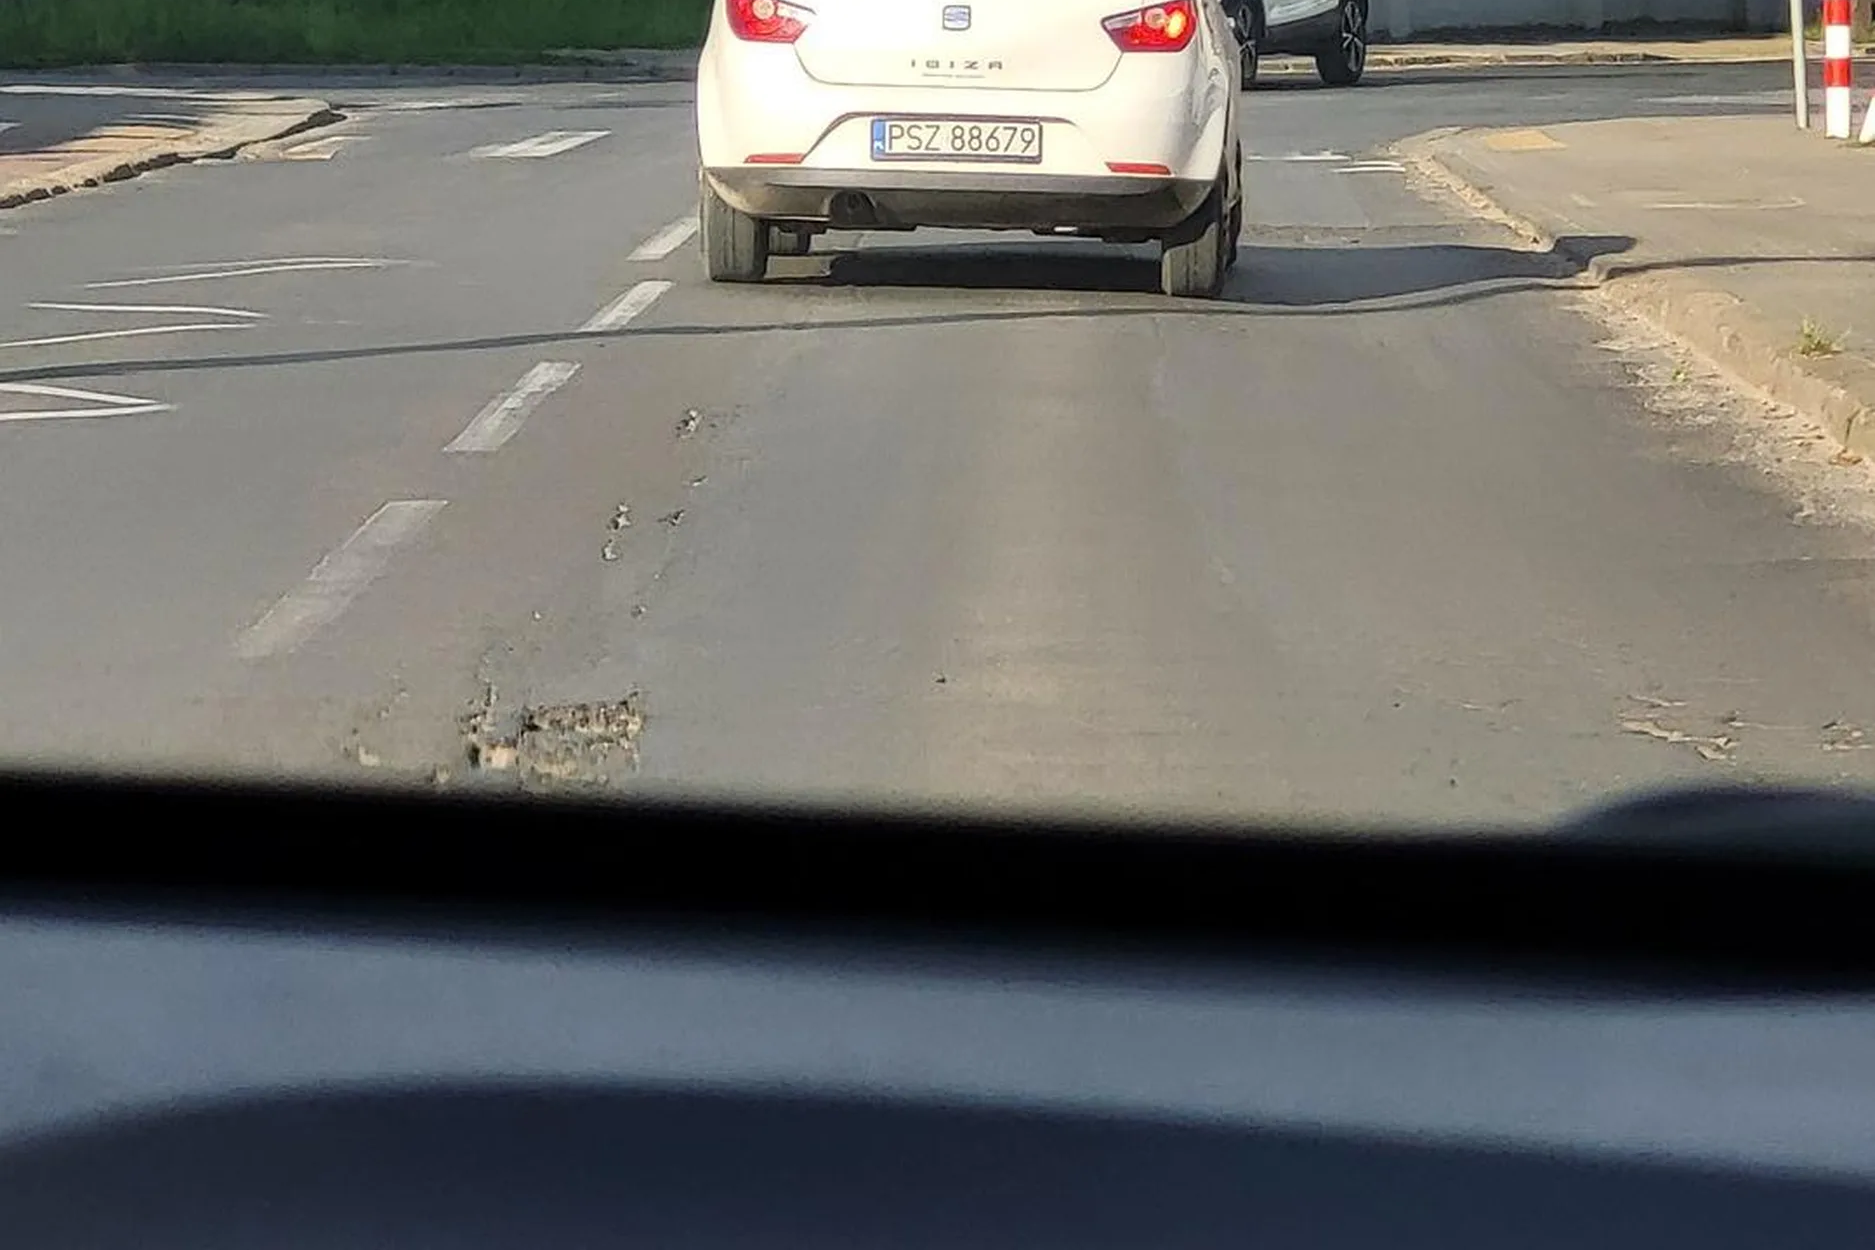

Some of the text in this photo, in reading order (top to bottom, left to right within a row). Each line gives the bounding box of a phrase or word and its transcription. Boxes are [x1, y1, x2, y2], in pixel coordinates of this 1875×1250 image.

[911, 58, 1003, 70] IBIZA
[888, 124, 1036, 154] PSZ 88679
